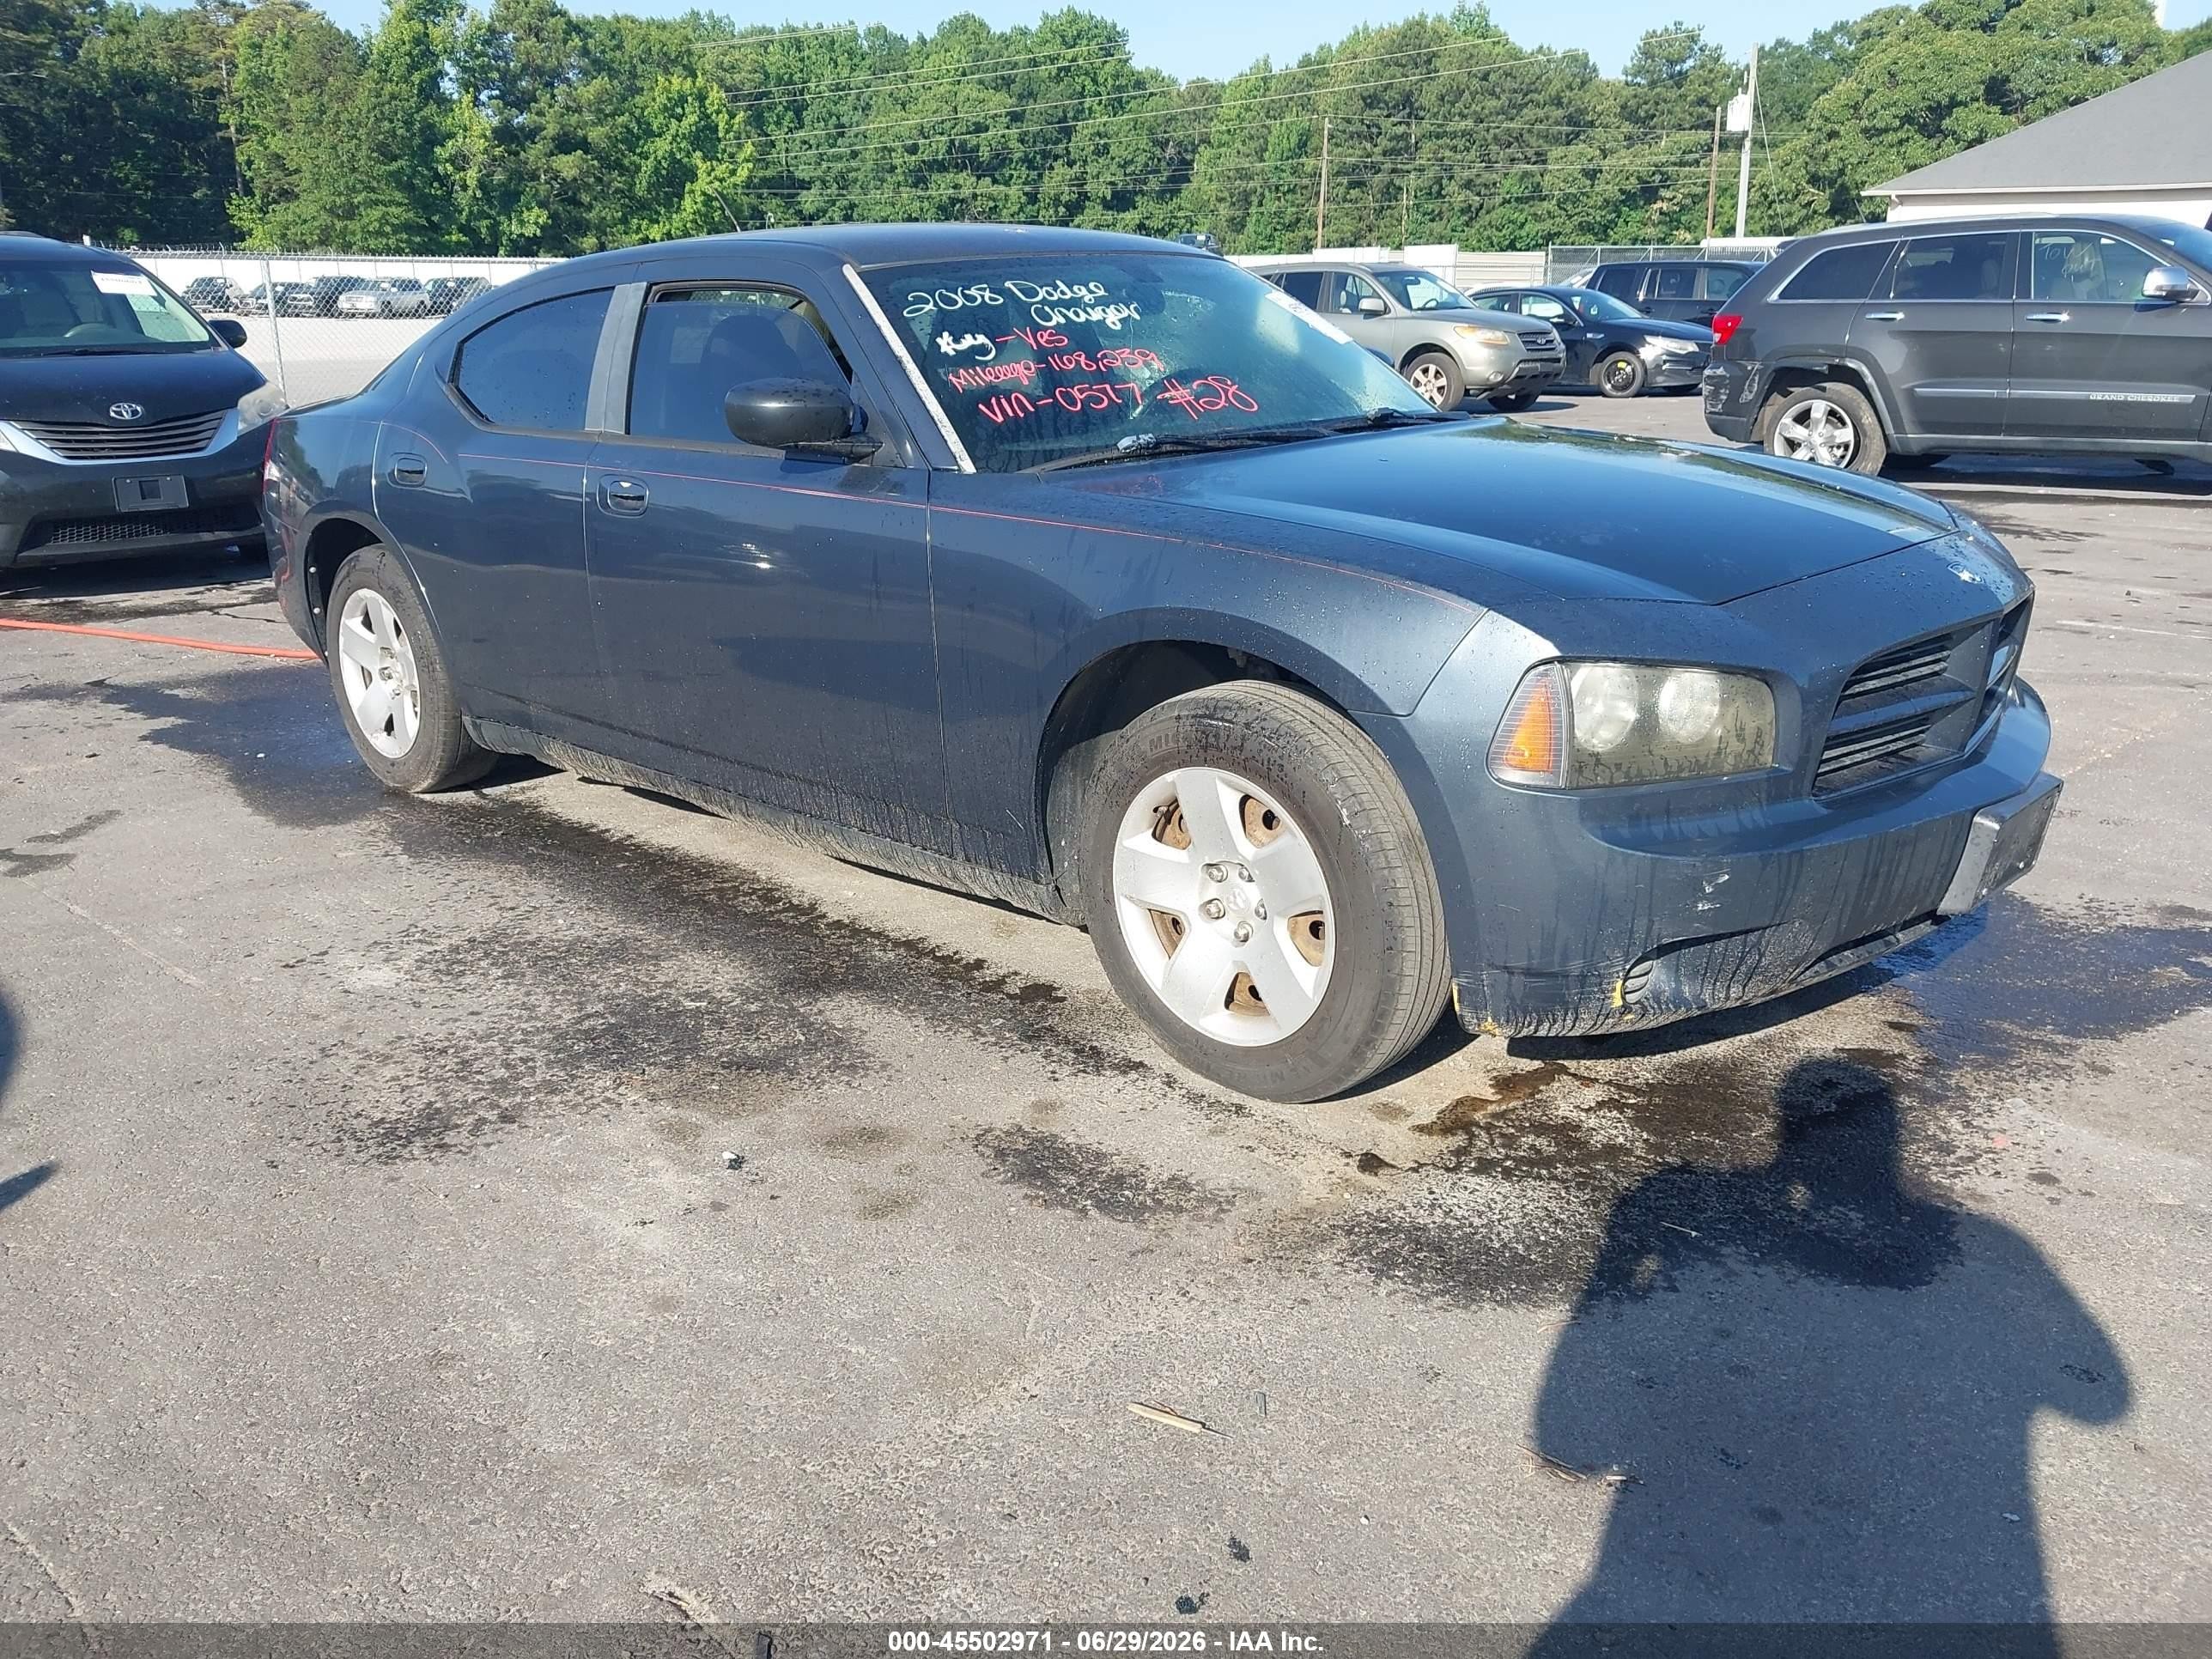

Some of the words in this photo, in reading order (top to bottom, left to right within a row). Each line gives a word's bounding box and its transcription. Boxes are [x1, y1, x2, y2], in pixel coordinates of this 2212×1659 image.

[902, 283, 1004, 318] 2008
[1004, 279, 1109, 303] Dodge
[1030, 301, 1142, 331] Charger
[1156, 375, 1259, 420] #28
[2089, 392, 2125, 401] GRAND
[2127, 393, 2181, 403] CHEROKEE
